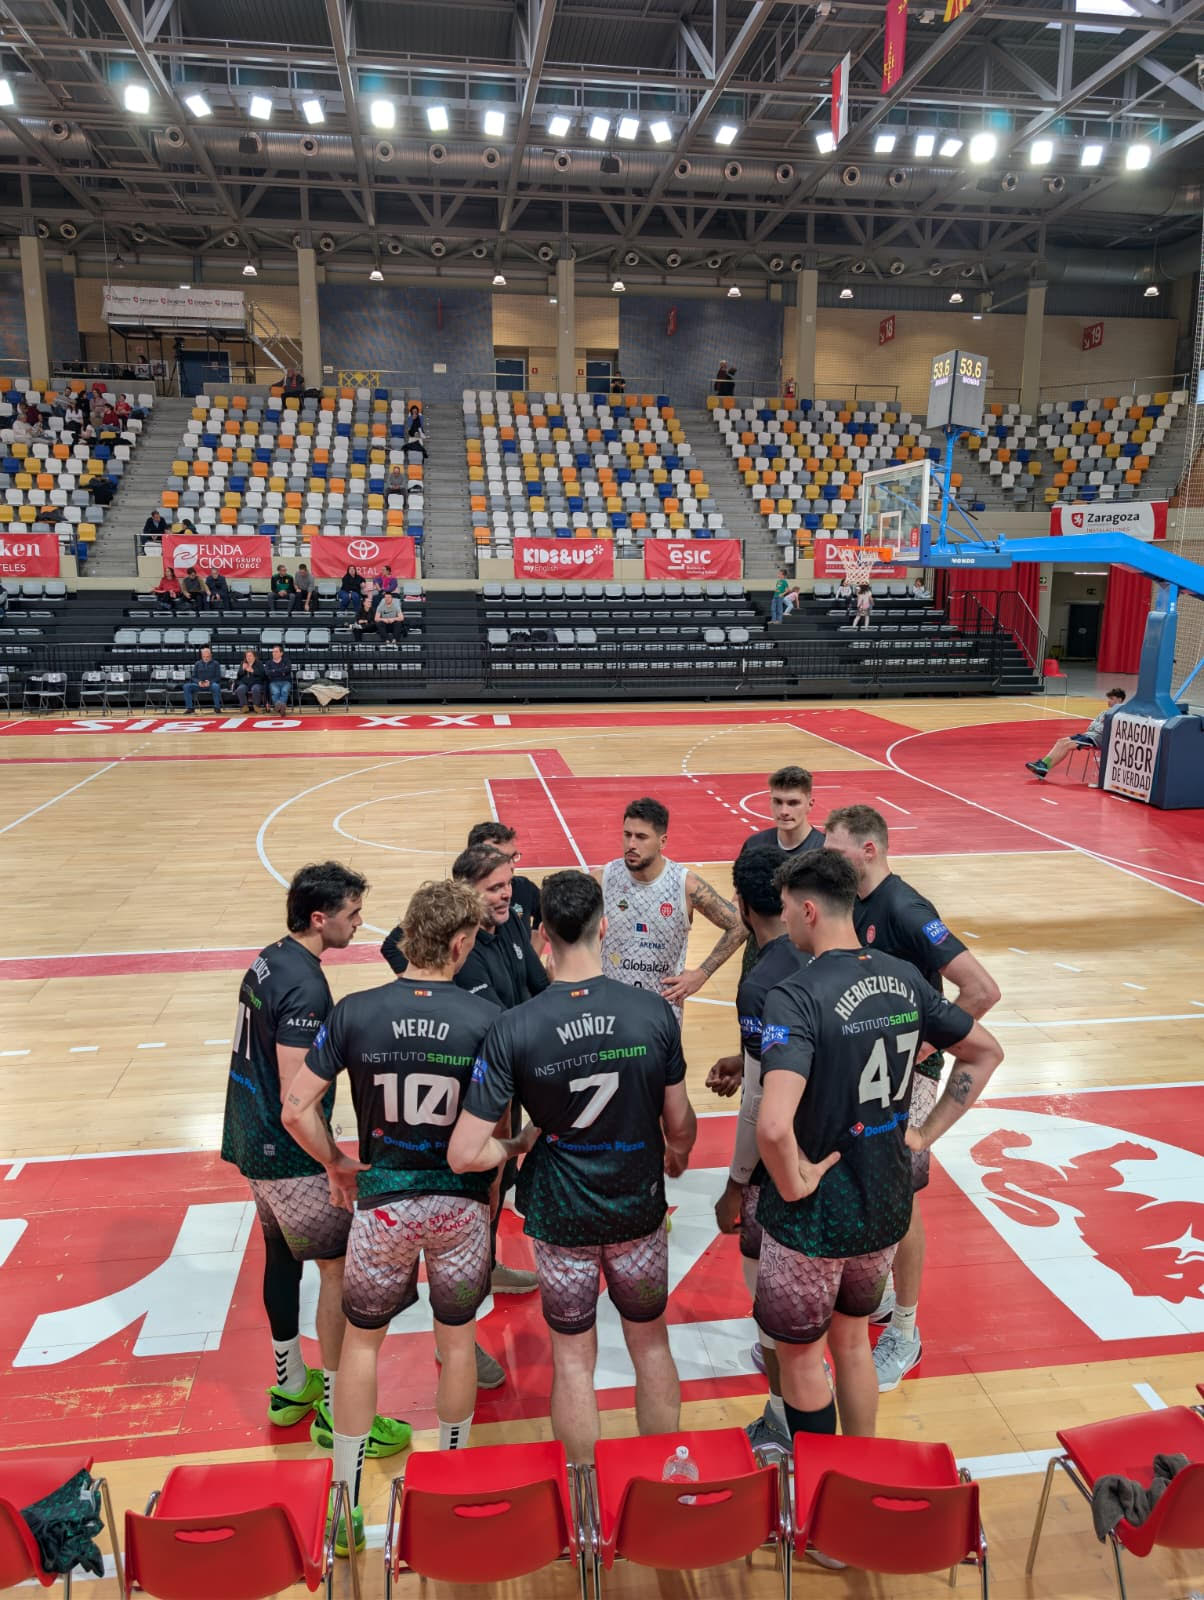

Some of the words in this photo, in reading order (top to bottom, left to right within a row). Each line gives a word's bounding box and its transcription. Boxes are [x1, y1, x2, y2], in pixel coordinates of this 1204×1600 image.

[1092, 326, 1101, 345] 19
[960, 357, 982, 378] 53.6
[1087, 512, 1140, 525] Zaragoza
[199, 544, 242, 556] FUNDA
[523, 548, 595, 564] KIDS&US
[0, 563, 26, 572] ELES
[199, 556, 233, 569] CIÓN
[54, 717, 304, 733] Siglo
[356, 714, 513, 727] XXI
[1113, 740, 1153, 774] SABOR
[1111, 766, 1121, 783] DE
[1122, 769, 1151, 791] VERDAD
[834, 975, 908, 1021] HIERREZUELO
[391, 1018, 450, 1041] MERLO
[555, 1012, 616, 1045] MUÑOZ
[858, 1029, 920, 1109] 47
[373, 1072, 461, 1127] 10
[568, 1071, 620, 1129] 7
